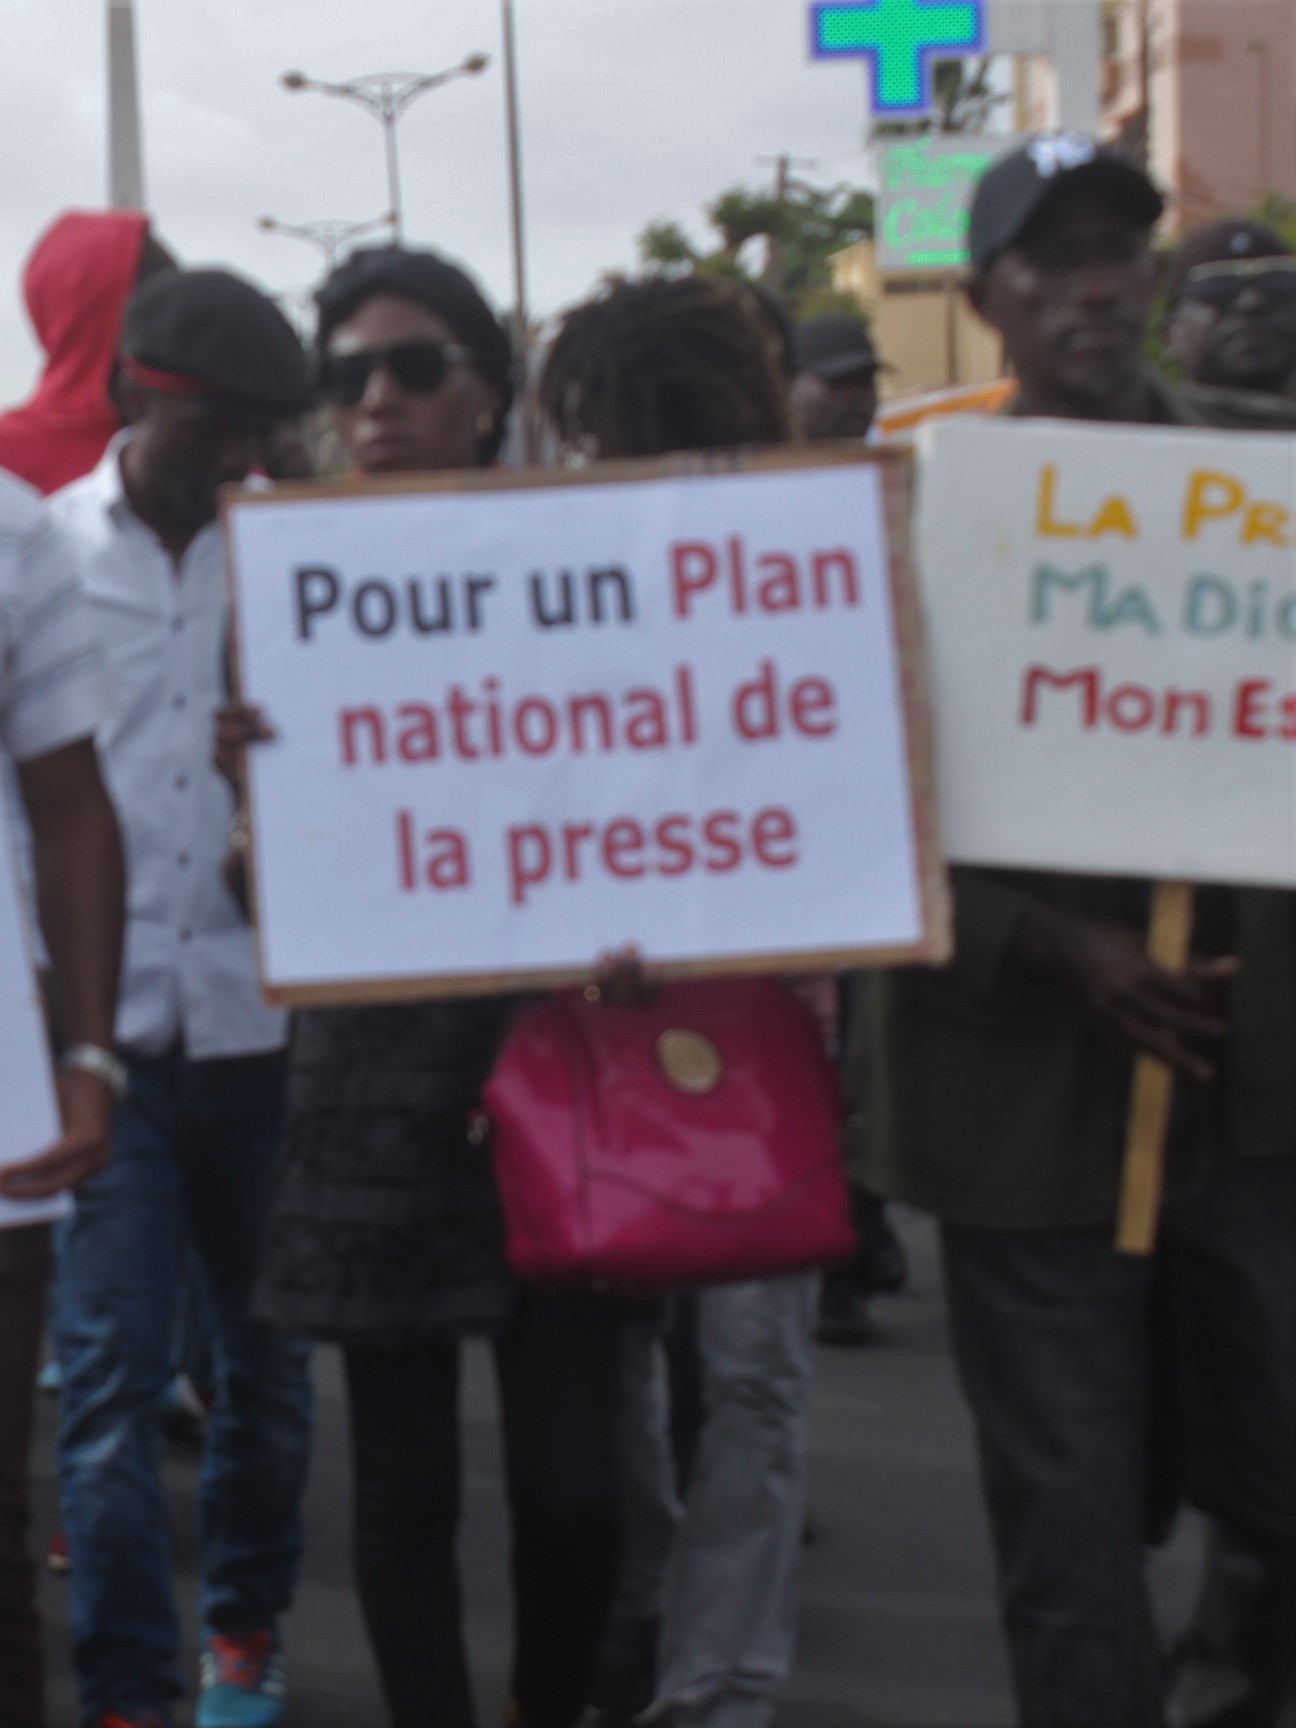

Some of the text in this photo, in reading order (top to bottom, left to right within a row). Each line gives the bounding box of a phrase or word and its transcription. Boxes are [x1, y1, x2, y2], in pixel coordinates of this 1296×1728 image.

[1181, 470, 1296, 547] PR
[292, 536, 861, 643] Pour un Plan
[338, 659, 837, 768] national de
[396, 806, 799, 908] la presse
